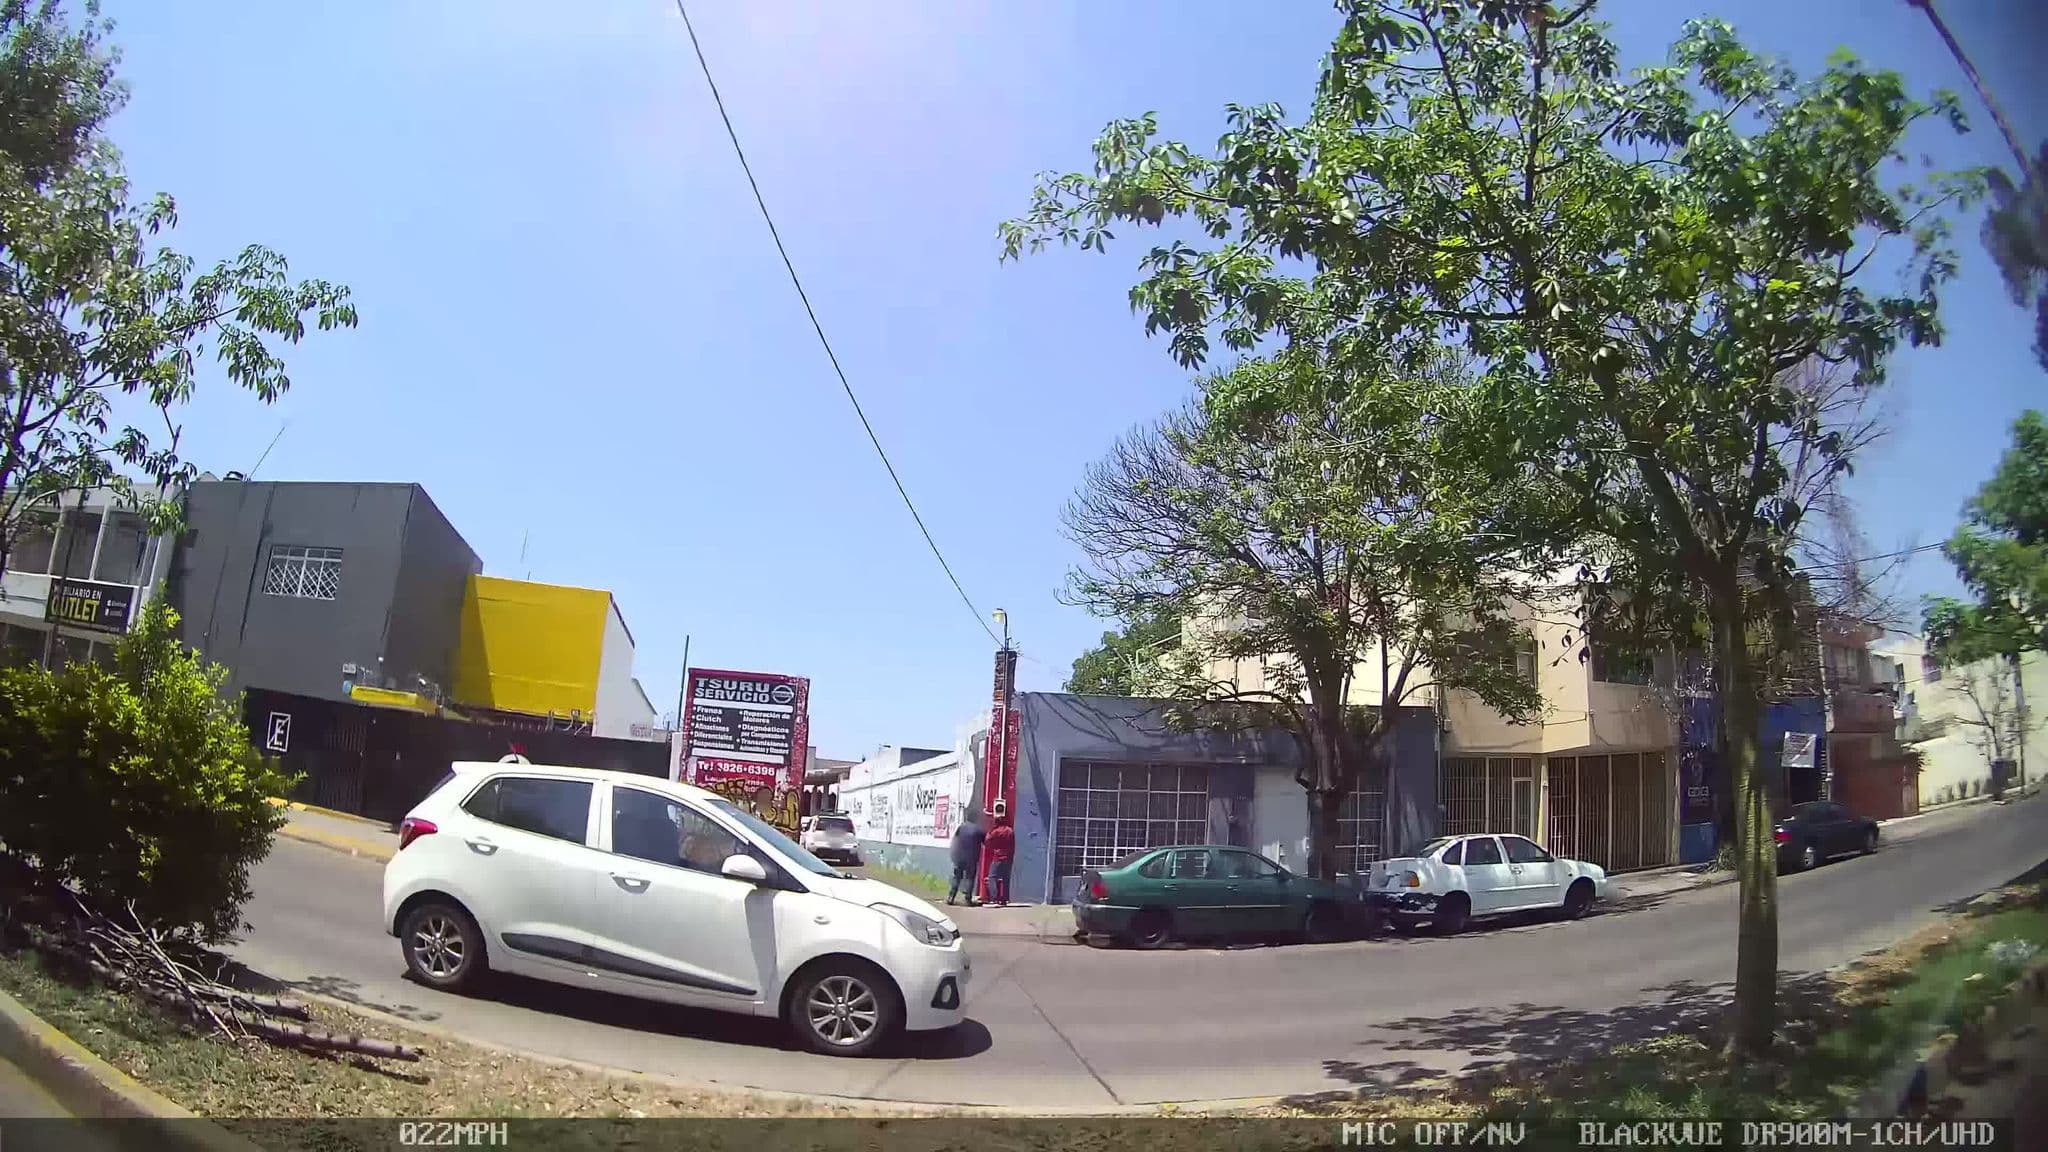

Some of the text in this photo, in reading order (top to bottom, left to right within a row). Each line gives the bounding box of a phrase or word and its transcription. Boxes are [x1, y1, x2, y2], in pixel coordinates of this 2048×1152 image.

[92, 590, 102, 600] EN
[51, 595, 101, 622] OUTLET
[695, 677, 770, 693] TSURU
[694, 688, 770, 703] SERVICIO
[697, 706, 723, 715] Frenos
[696, 714, 722, 723] Clutch
[915, 784, 937, 815] Super
